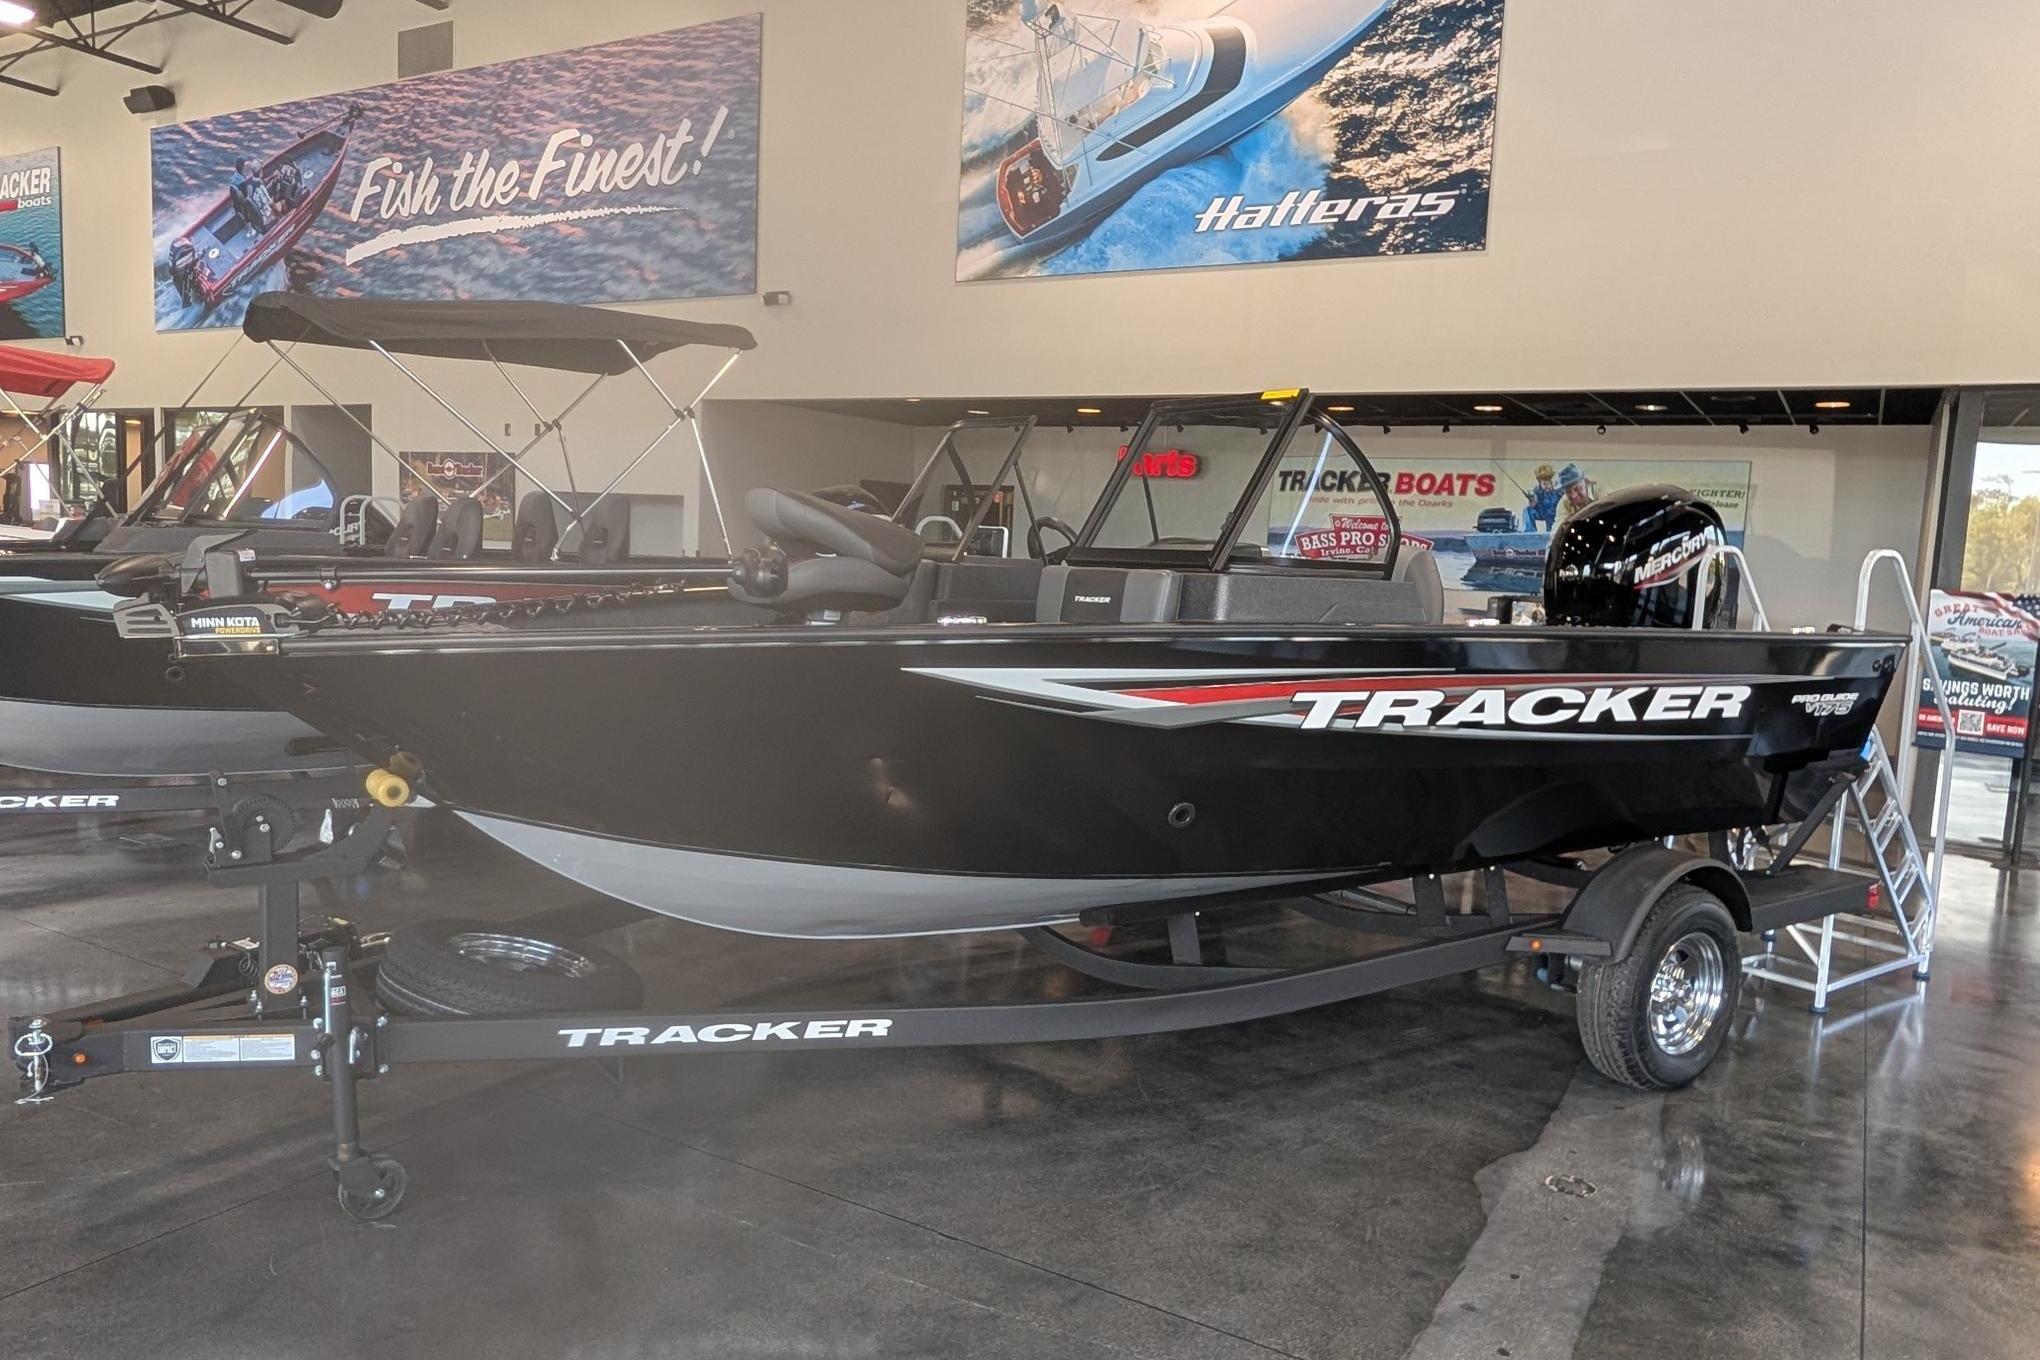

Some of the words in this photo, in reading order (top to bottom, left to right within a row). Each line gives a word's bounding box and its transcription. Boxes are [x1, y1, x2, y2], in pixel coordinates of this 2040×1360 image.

[350, 156, 441, 223] Fish
[449, 147, 520, 213] the
[528, 105, 729, 201] Finest!
[0, 167, 51, 199] ACKER
[17, 196, 52, 209] boats
[1194, 189, 1460, 233] Hatteras
[1117, 446, 1198, 477] arts
[1394, 472, 1496, 497] BOATS
[1341, 517, 1379, 530] Welcome
[1300, 532, 1337, 551] BASS
[1339, 531, 1375, 546] PRO
[1633, 531, 1708, 584] MERCURY
[1074, 595, 1111, 603] TRACKER
[1934, 603, 1978, 617] GREAT
[190, 617, 225, 628] MINN
[226, 616, 260, 627] KOTA
[1947, 612, 2023, 629] American
[1791, 693, 1820, 704] PRO
[1820, 691, 1859, 701] GUIDE
[1922, 678, 1979, 695] SVINGS
[1982, 683, 2030, 700] WORTH
[1291, 685, 1752, 730] TRACKER
[1986, 723, 2005, 732] SAVE
[2007, 725, 2025, 735] NOW
[0, 795, 120, 808] CKER
[557, 1018, 893, 1047] TRACKER
